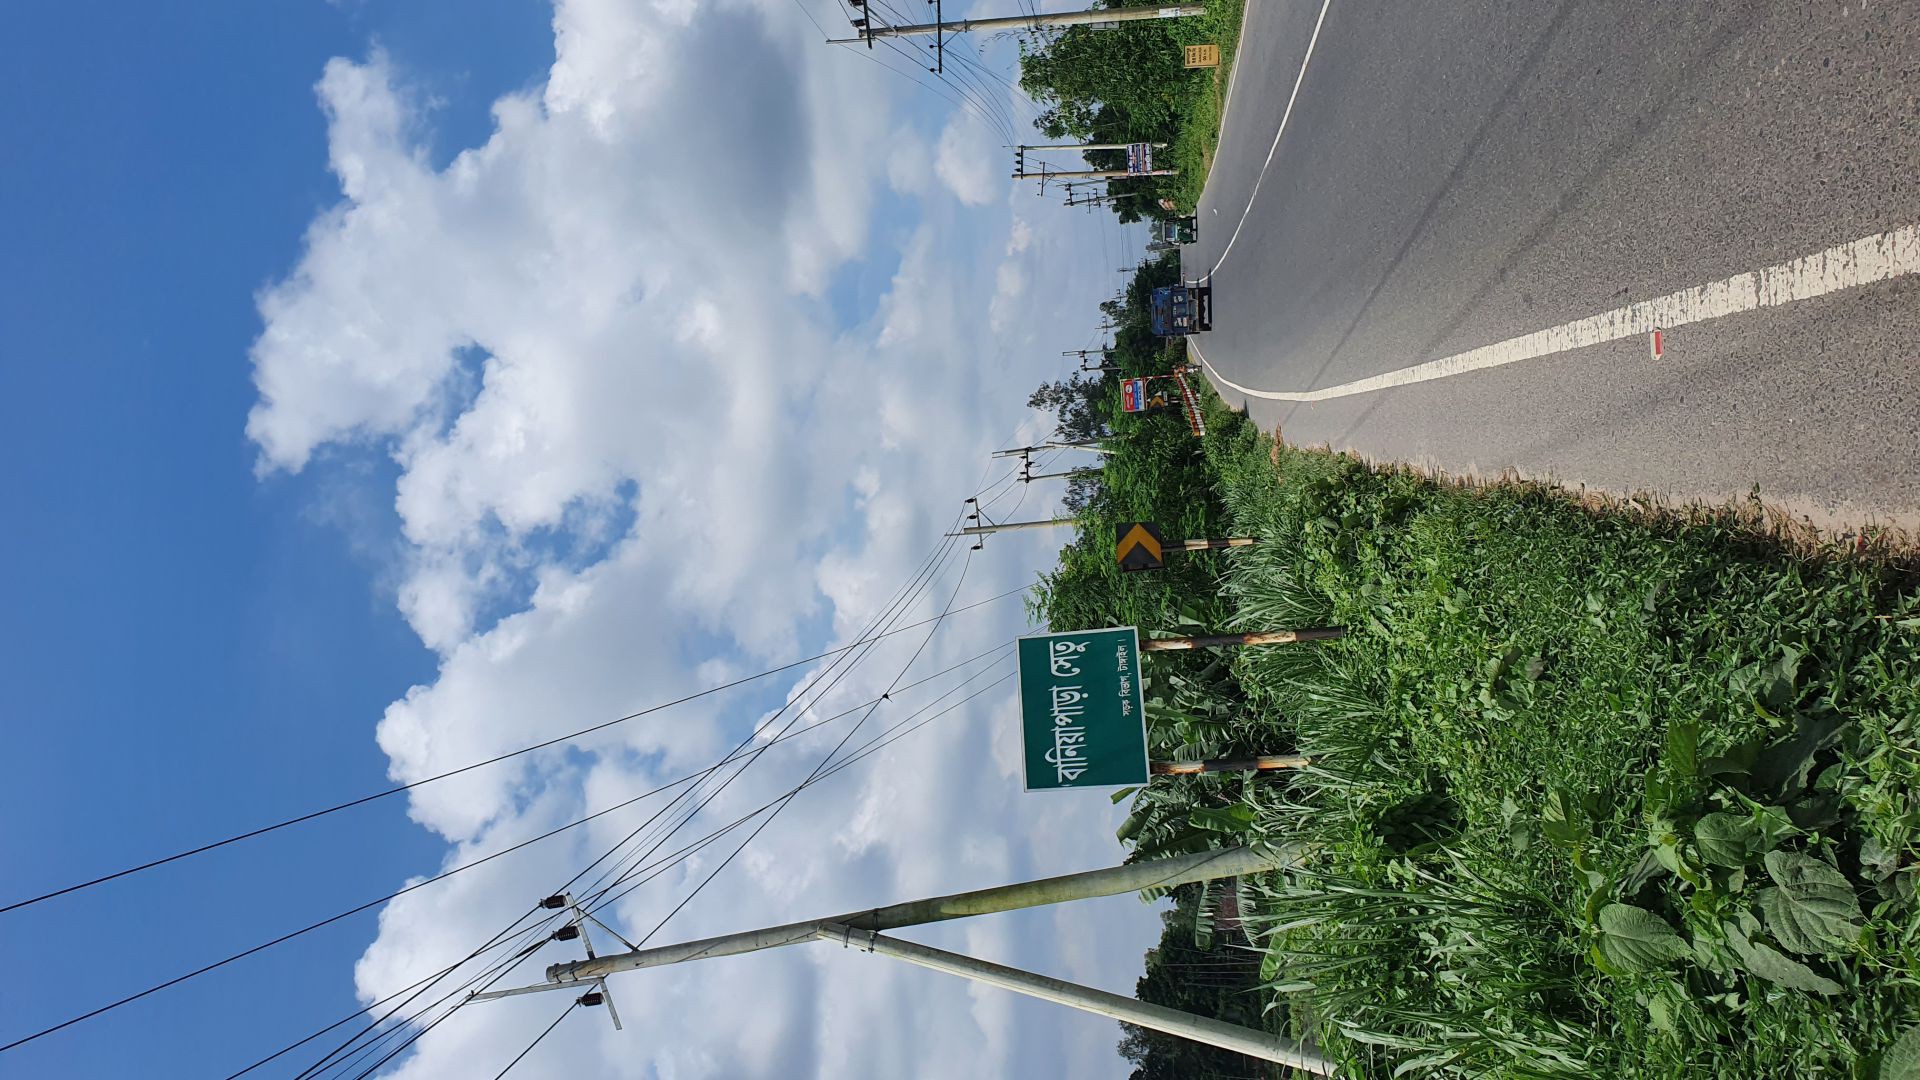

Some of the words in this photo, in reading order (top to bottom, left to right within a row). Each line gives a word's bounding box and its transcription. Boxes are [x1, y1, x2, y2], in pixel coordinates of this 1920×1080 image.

[1049, 640, 1092, 677] সেতু
[1121, 699, 1134, 717] সড়ক
[1044, 685, 1089, 783] বানিয়াপাড়া
